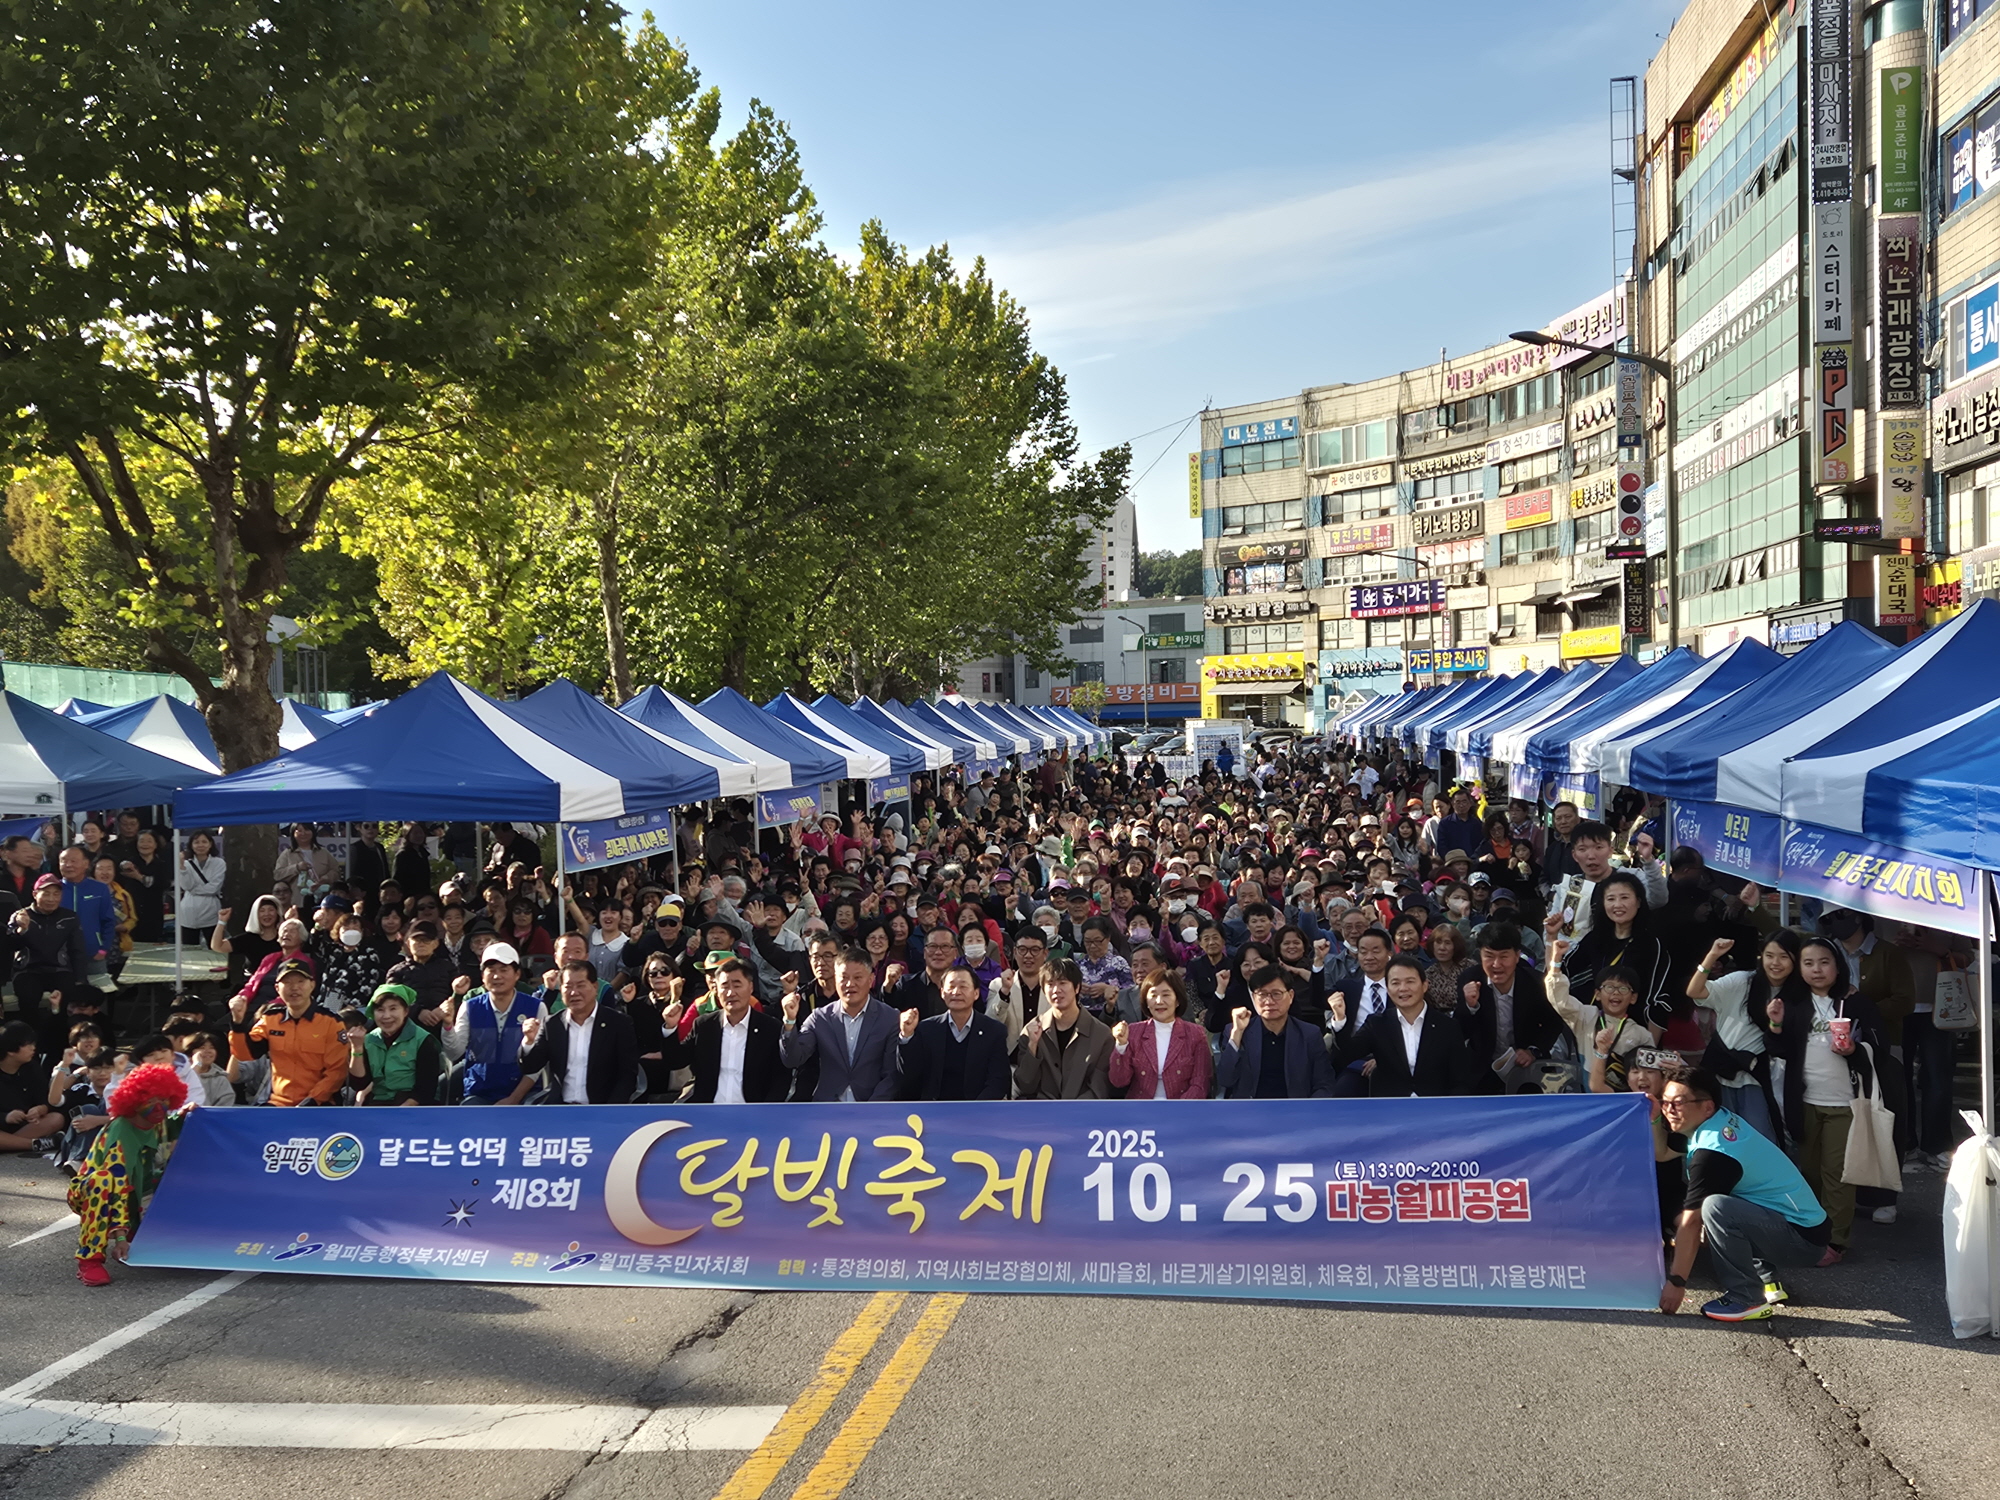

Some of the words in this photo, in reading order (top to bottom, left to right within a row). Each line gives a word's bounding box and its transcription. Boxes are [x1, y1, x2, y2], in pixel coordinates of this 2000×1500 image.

[1825, 129, 1837, 138] 2F
[1894, 104, 1908, 174] 골프존파크
[1815, 143, 1847, 154] 24시간영업
[1819, 154, 1844, 165] 수면가능
[1893, 197, 1909, 209] 4F
[1821, 230, 1843, 238] 도토리
[1824, 243, 1842, 332] 스터디카페
[1620, 363, 1639, 374] 제일
[1621, 374, 1637, 431] 골프스쿨
[1623, 436, 1636, 444] 4F
[1823, 458, 1848, 481] 6층
[1414, 509, 1471, 537] 럭키노래광장
[1626, 526, 1637, 535] 6F
[1266, 544, 1286, 556] PC방
[1382, 582, 1433, 606] 동서가구
[1887, 567, 1908, 613] 순대국
[1203, 600, 1285, 620] 친구노래광장
[1628, 585, 1644, 627] 노래광장
[1411, 653, 1430, 670] 가구
[1454, 649, 1487, 668] 전시장
[1055, 684, 1200, 703] 가방설비그
[1824, 849, 1965, 908] 월피동주민자치회
[518, 1137, 593, 1169] 월피동
[1088, 1129, 1164, 1158] 2025.
[264, 1143, 316, 1174] 월피동
[675, 1113, 1053, 1233] 달빛축제
[491, 1177, 581, 1211] 제8회
[1082, 1163, 1198, 1222] 10.
[1222, 1163, 1318, 1222] 25
[322, 1241, 489, 1268] 월피동행정복지센터
[510, 1252, 536, 1268] 주관
[599, 1252, 750, 1276] 월피동주민자치회
[821, 1258, 910, 1282] 통장협의회,
[1081, 1262, 1157, 1287] 새마을회,
[1162, 1263, 1308, 1288] 바르게살기위원회,
[1317, 1264, 1379, 1289] 체육회,
[1384, 1264, 1486, 1290] 자율방범대,
[1489, 1265, 1586, 1291] 자율방재단
